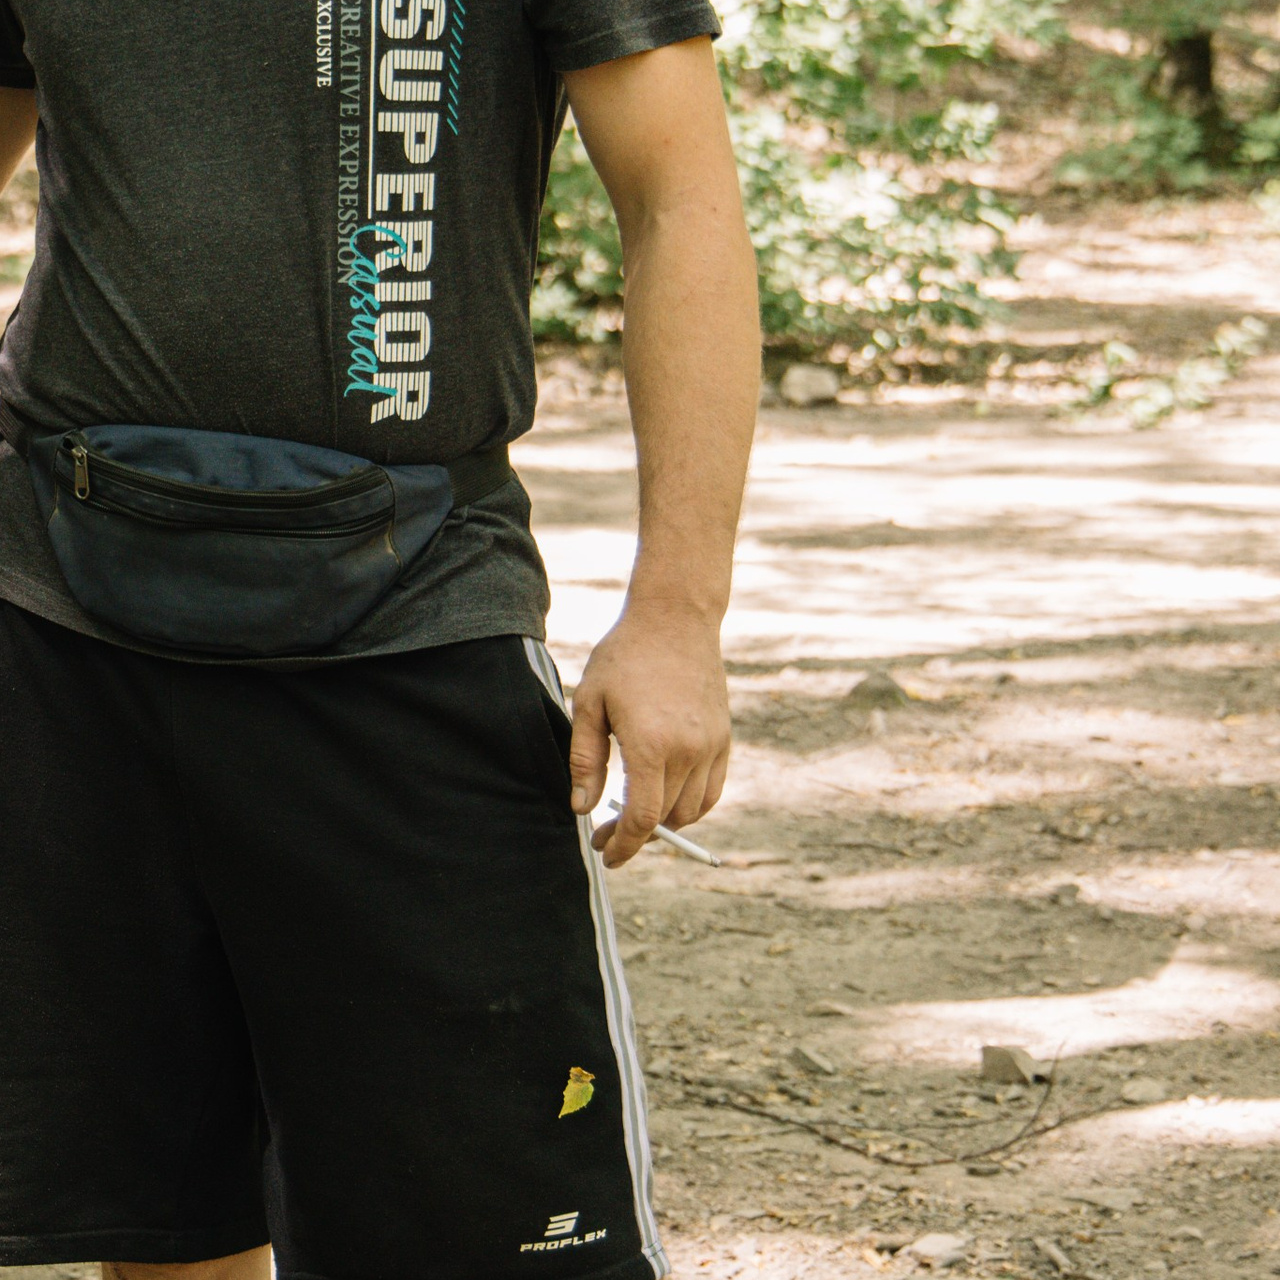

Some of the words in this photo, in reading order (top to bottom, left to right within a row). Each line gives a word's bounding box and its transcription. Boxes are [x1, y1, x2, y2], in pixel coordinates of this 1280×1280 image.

[338, 126, 361, 285] EXPRESSION
[344, 224, 407, 398] Casual
[520, 1228, 607, 1253] PROFLEX
